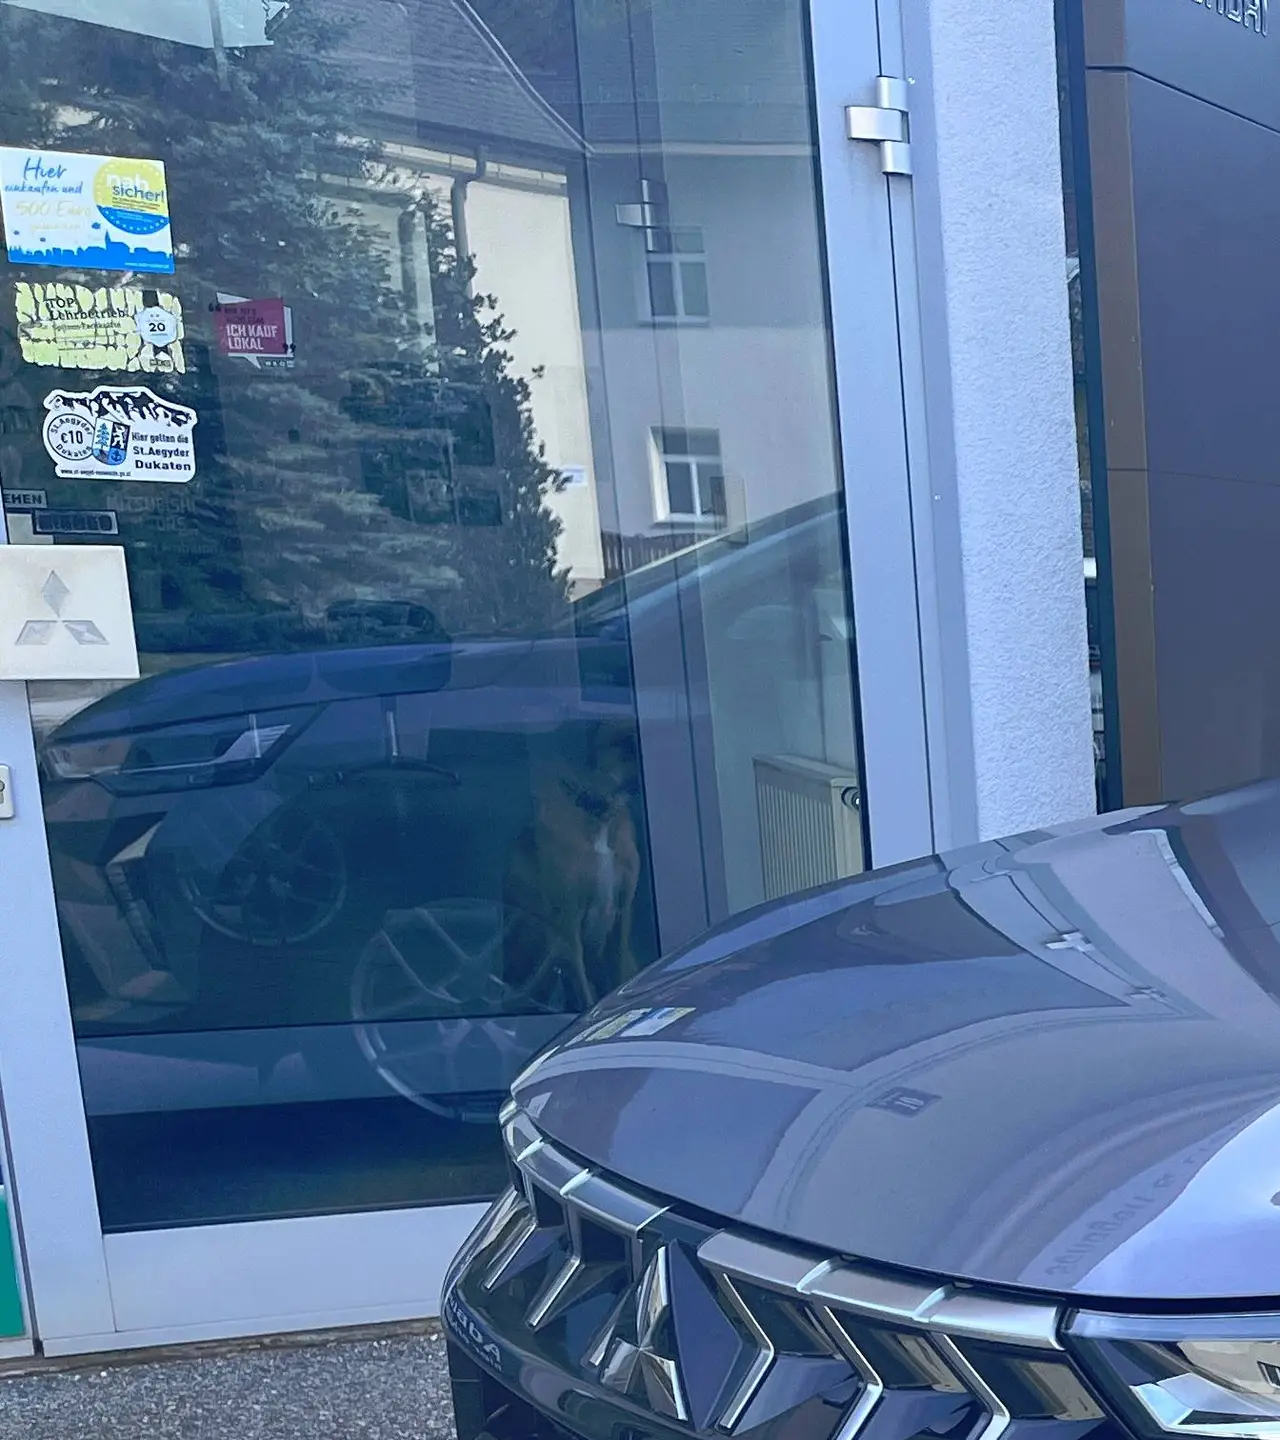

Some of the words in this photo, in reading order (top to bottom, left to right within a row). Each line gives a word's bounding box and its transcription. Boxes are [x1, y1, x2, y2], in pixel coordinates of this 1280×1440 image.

[23, 156, 67, 180] Hier
[62, 181, 83, 194] und
[112, 184, 165, 203] sicher!
[48, 297, 75, 309] TOP
[149, 322, 166, 333] 20
[226, 324, 246, 337] ICH
[248, 325, 278, 338] KAUF
[228, 337, 264, 350] LOKAL
[60, 430, 84, 445] €10
[131, 431, 148, 441] Hier
[177, 433, 189, 443] die
[55, 443, 92, 457] Dukaten
[135, 459, 191, 471] Dukaten
